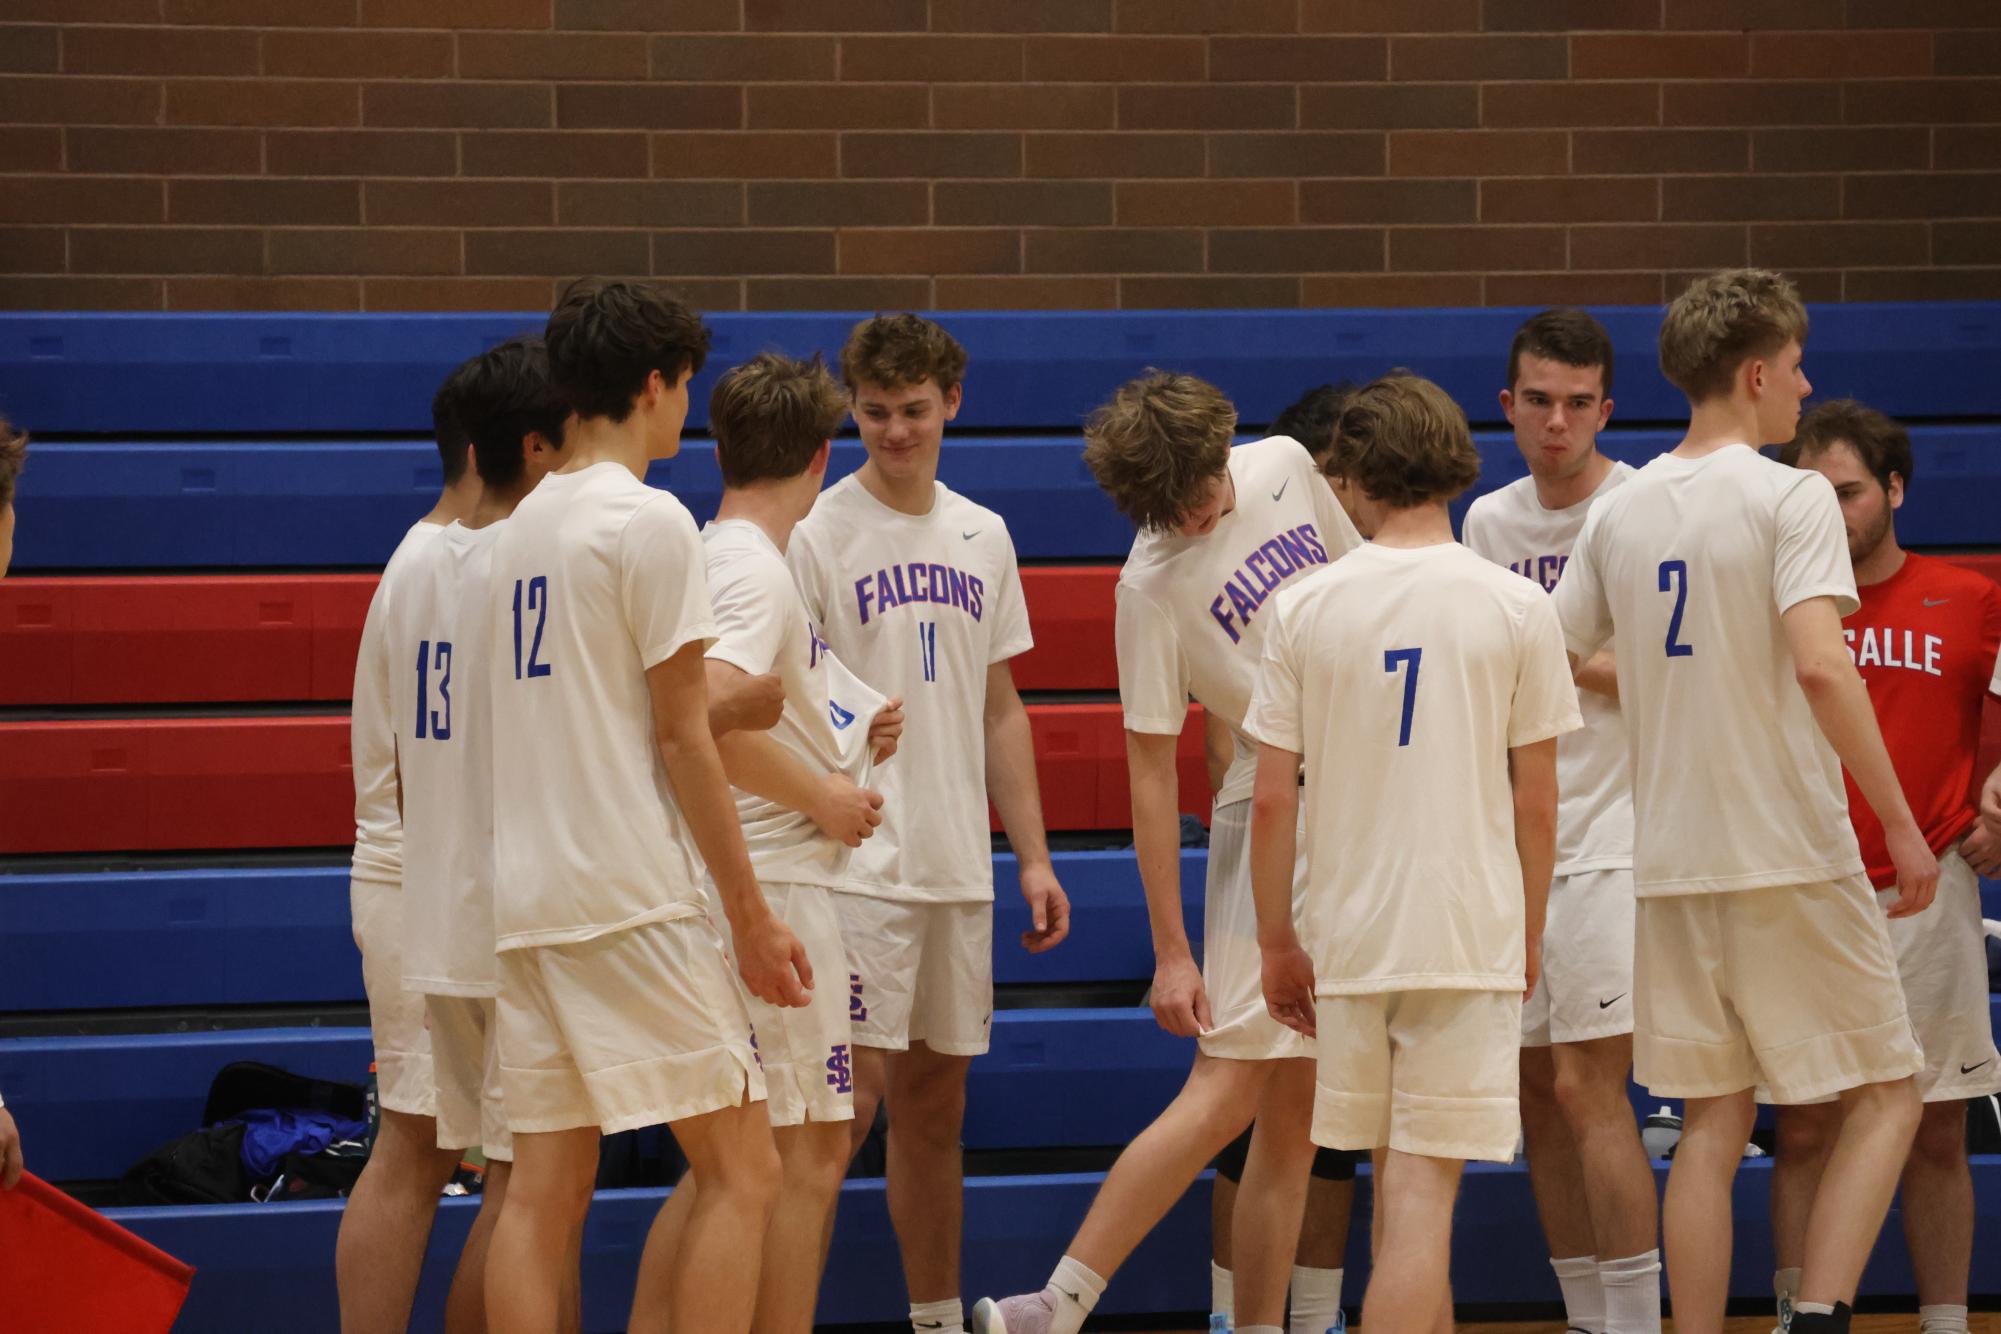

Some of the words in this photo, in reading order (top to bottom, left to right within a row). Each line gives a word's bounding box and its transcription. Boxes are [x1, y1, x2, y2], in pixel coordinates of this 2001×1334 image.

[512, 575, 550, 680] 12
[854, 562, 984, 625] FALCONS
[1209, 523, 1329, 645] FALCONS
[1658, 560, 1693, 657] 2
[415, 640, 452, 740] 13
[919, 622, 935, 682] 11
[1384, 647, 1422, 747] 7
